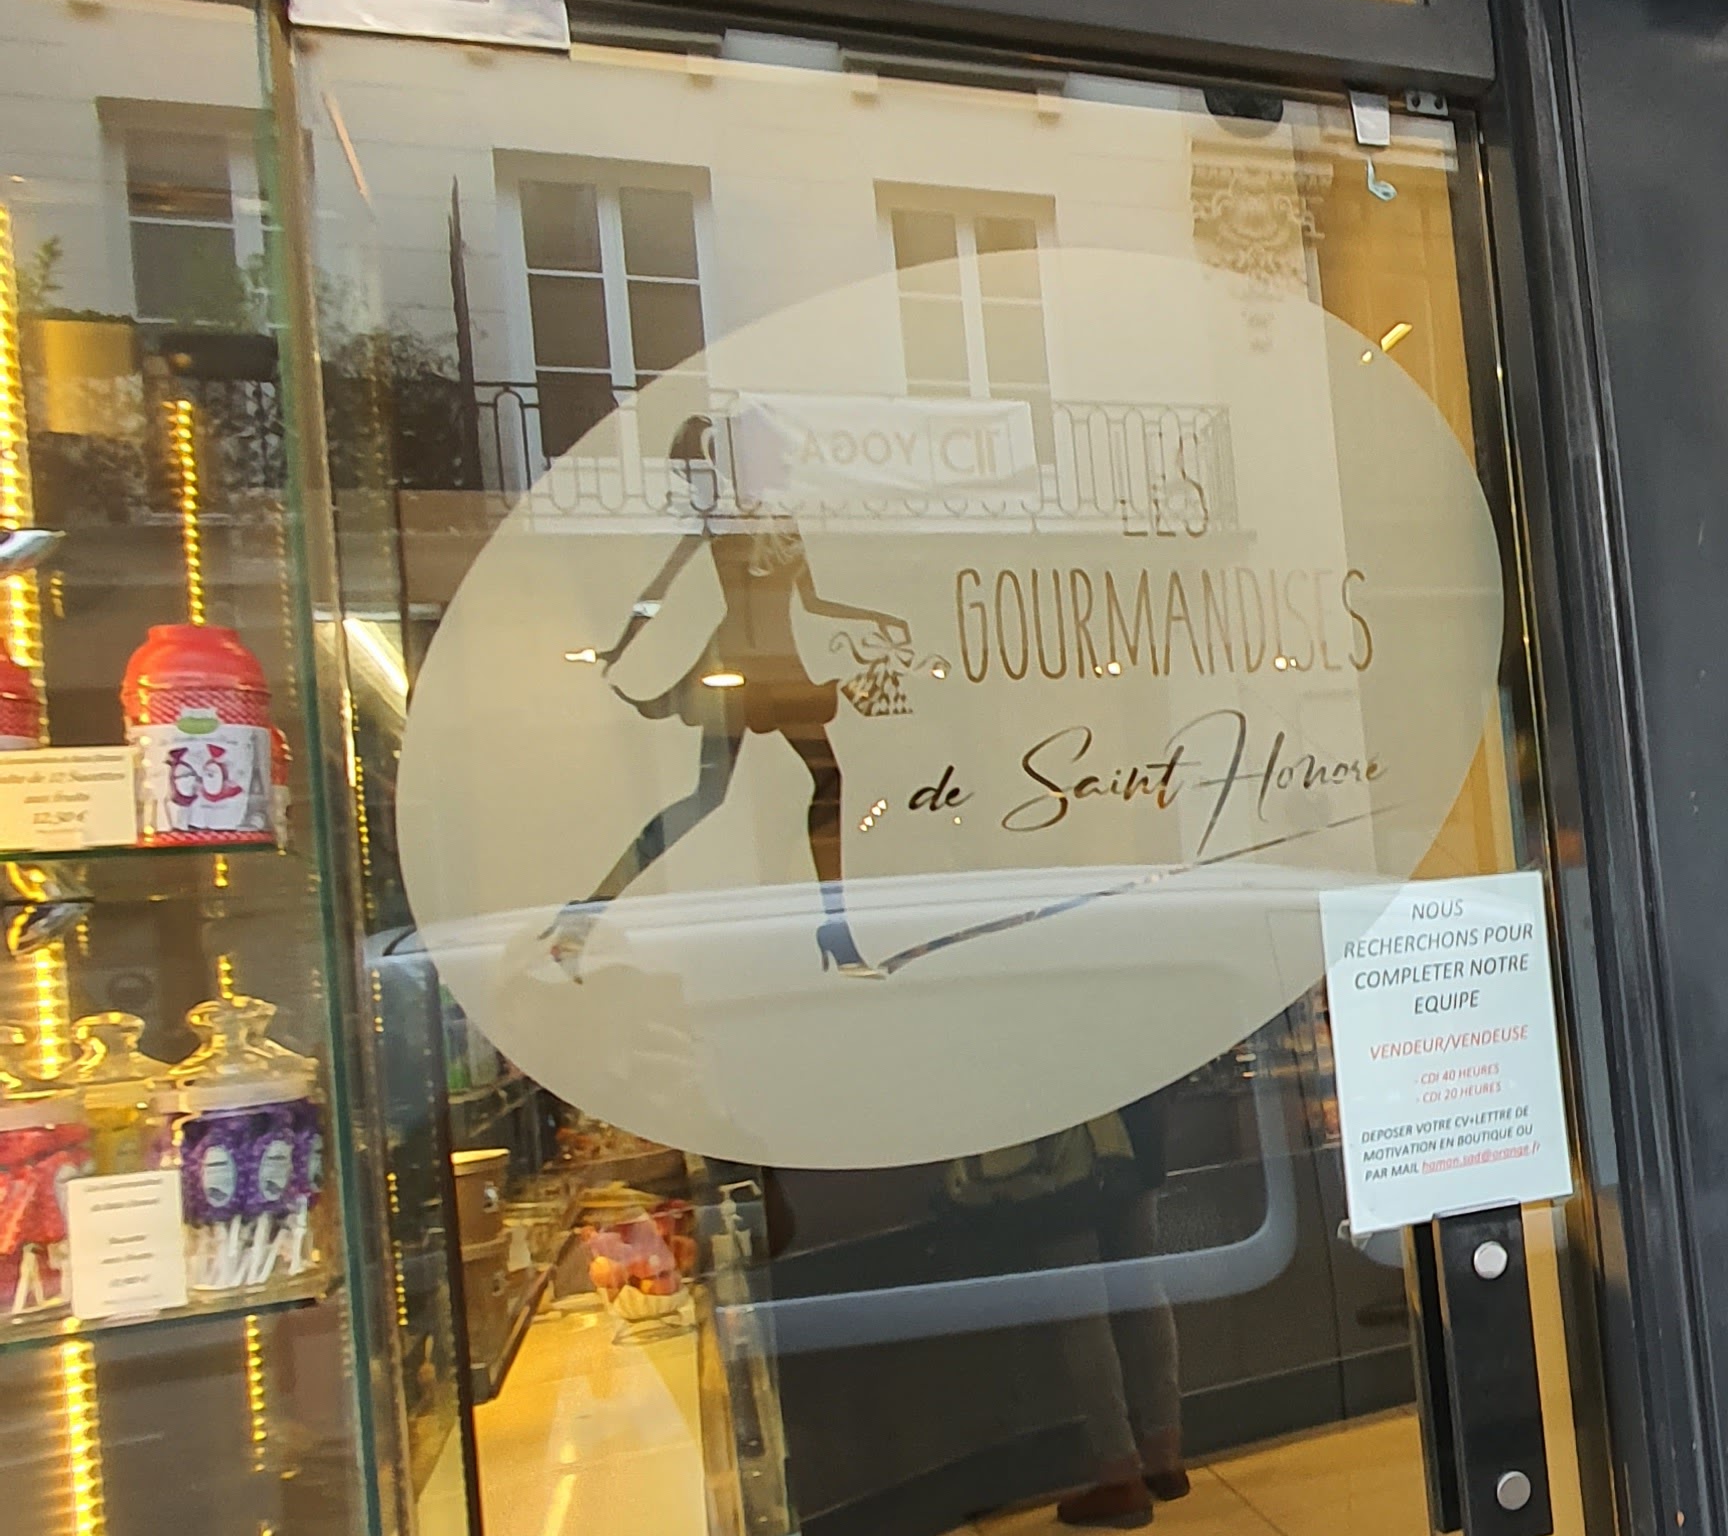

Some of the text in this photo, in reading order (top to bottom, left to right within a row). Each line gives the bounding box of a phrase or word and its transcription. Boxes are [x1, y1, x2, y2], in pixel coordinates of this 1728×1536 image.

[956, 567, 1374, 684] GOURMANDISES
[908, 764, 975, 812] de
[1001, 726, 1202, 833] Saint
[1412, 899, 1464, 921] NOUS
[1344, 923, 1534, 958] RECHERCHONS POUR
[1355, 953, 1529, 990] COMPLETER NOTRE
[1414, 989, 1480, 1015] EQUIPE
[1370, 1024, 1529, 1062] VENDEUR/VENDEUSE
[1420, 1072, 1440, 1085] CDI
[1442, 1068, 1456, 1082] 40
[1458, 1063, 1500, 1079] HEURES
[1423, 1090, 1441, 1104] CDI
[1444, 1087, 1458, 1101] 20
[1460, 1081, 1502, 1098] HEURES
[1362, 1105, 1529, 1144] DEPOSER VOTRE CV+LETTRE DE
[1363, 1124, 1533, 1163] MOTIVATION EN BOUTIQUE OU
[1365, 1167, 1388, 1183] PAR
[1391, 1162, 1420, 1177] MAIL
